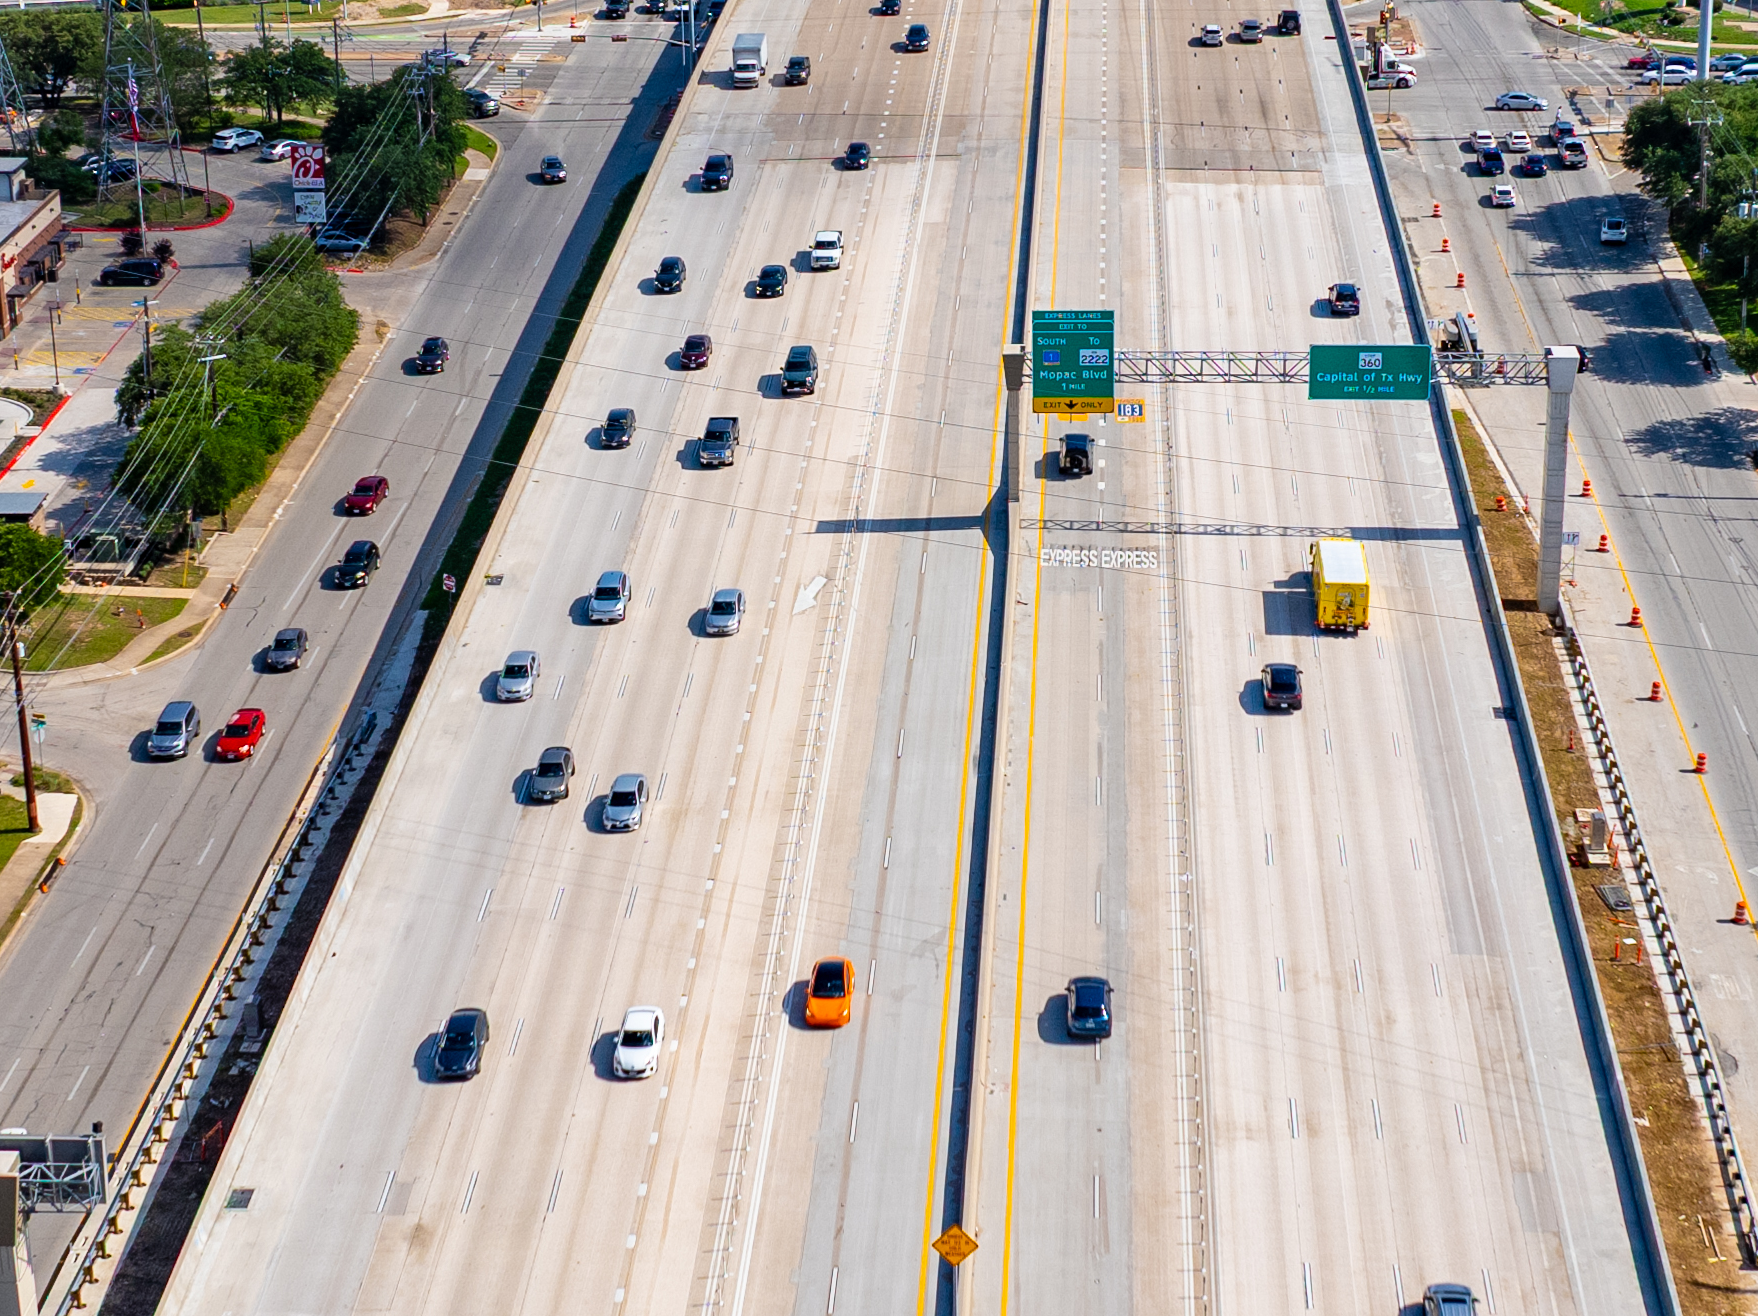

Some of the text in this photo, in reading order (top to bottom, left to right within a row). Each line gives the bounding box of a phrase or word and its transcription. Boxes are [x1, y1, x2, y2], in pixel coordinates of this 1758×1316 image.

[1037, 336, 1066, 345] SOUTH
[1081, 354, 1108, 364] 2222
[1360, 359, 1381, 367] 360
[1040, 370, 1107, 381] Mopac Blvd
[1317, 372, 1422, 384] Capital of Tx Hwy
[1363, 385, 1375, 393] 1/2
[1120, 404, 1139, 416] 183
[1040, 549, 1157, 569] EXPRESS EXPRESS
